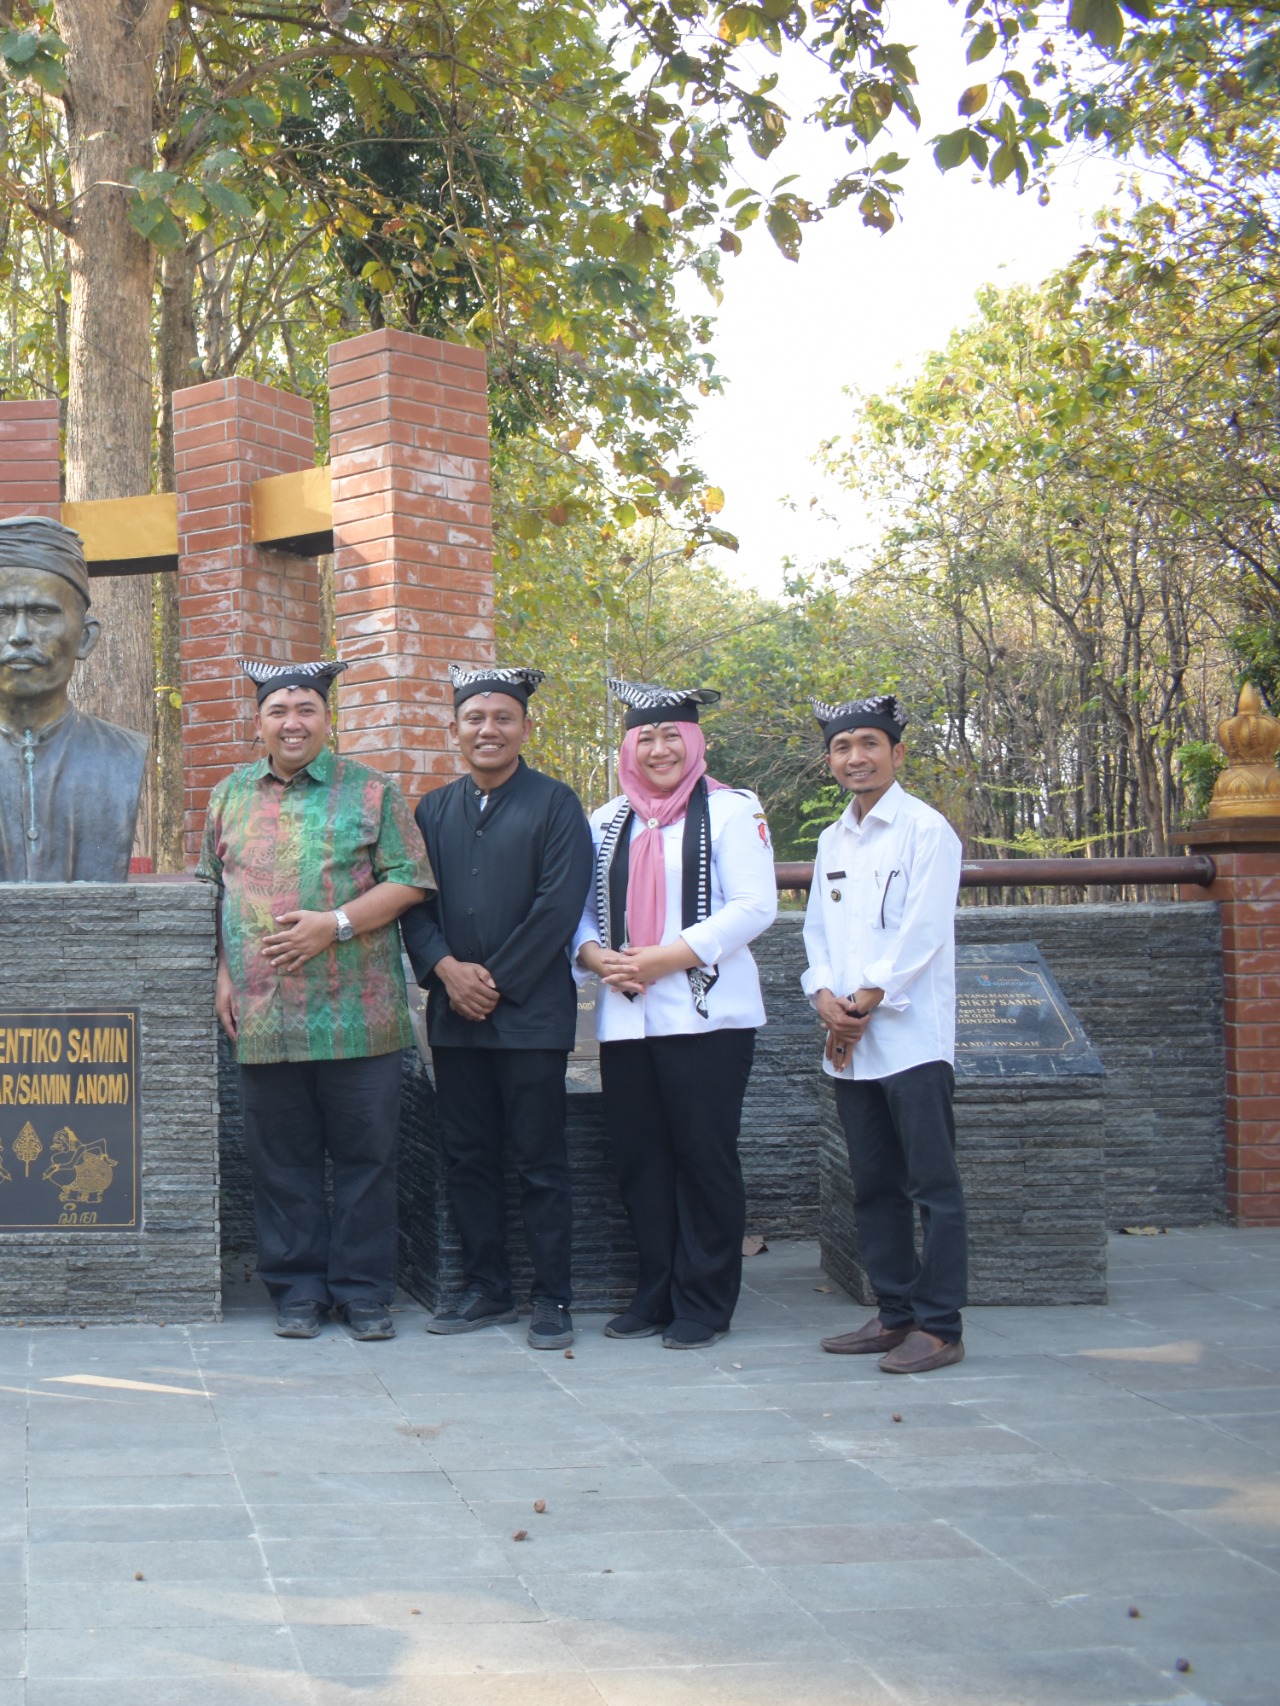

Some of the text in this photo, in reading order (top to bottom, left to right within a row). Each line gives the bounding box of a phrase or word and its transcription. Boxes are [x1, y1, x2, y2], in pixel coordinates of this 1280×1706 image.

[959, 999, 997, 1007] SIKEP
[67, 1027, 128, 1063] SAMIN
[75, 1072, 130, 1105] ANOM)
